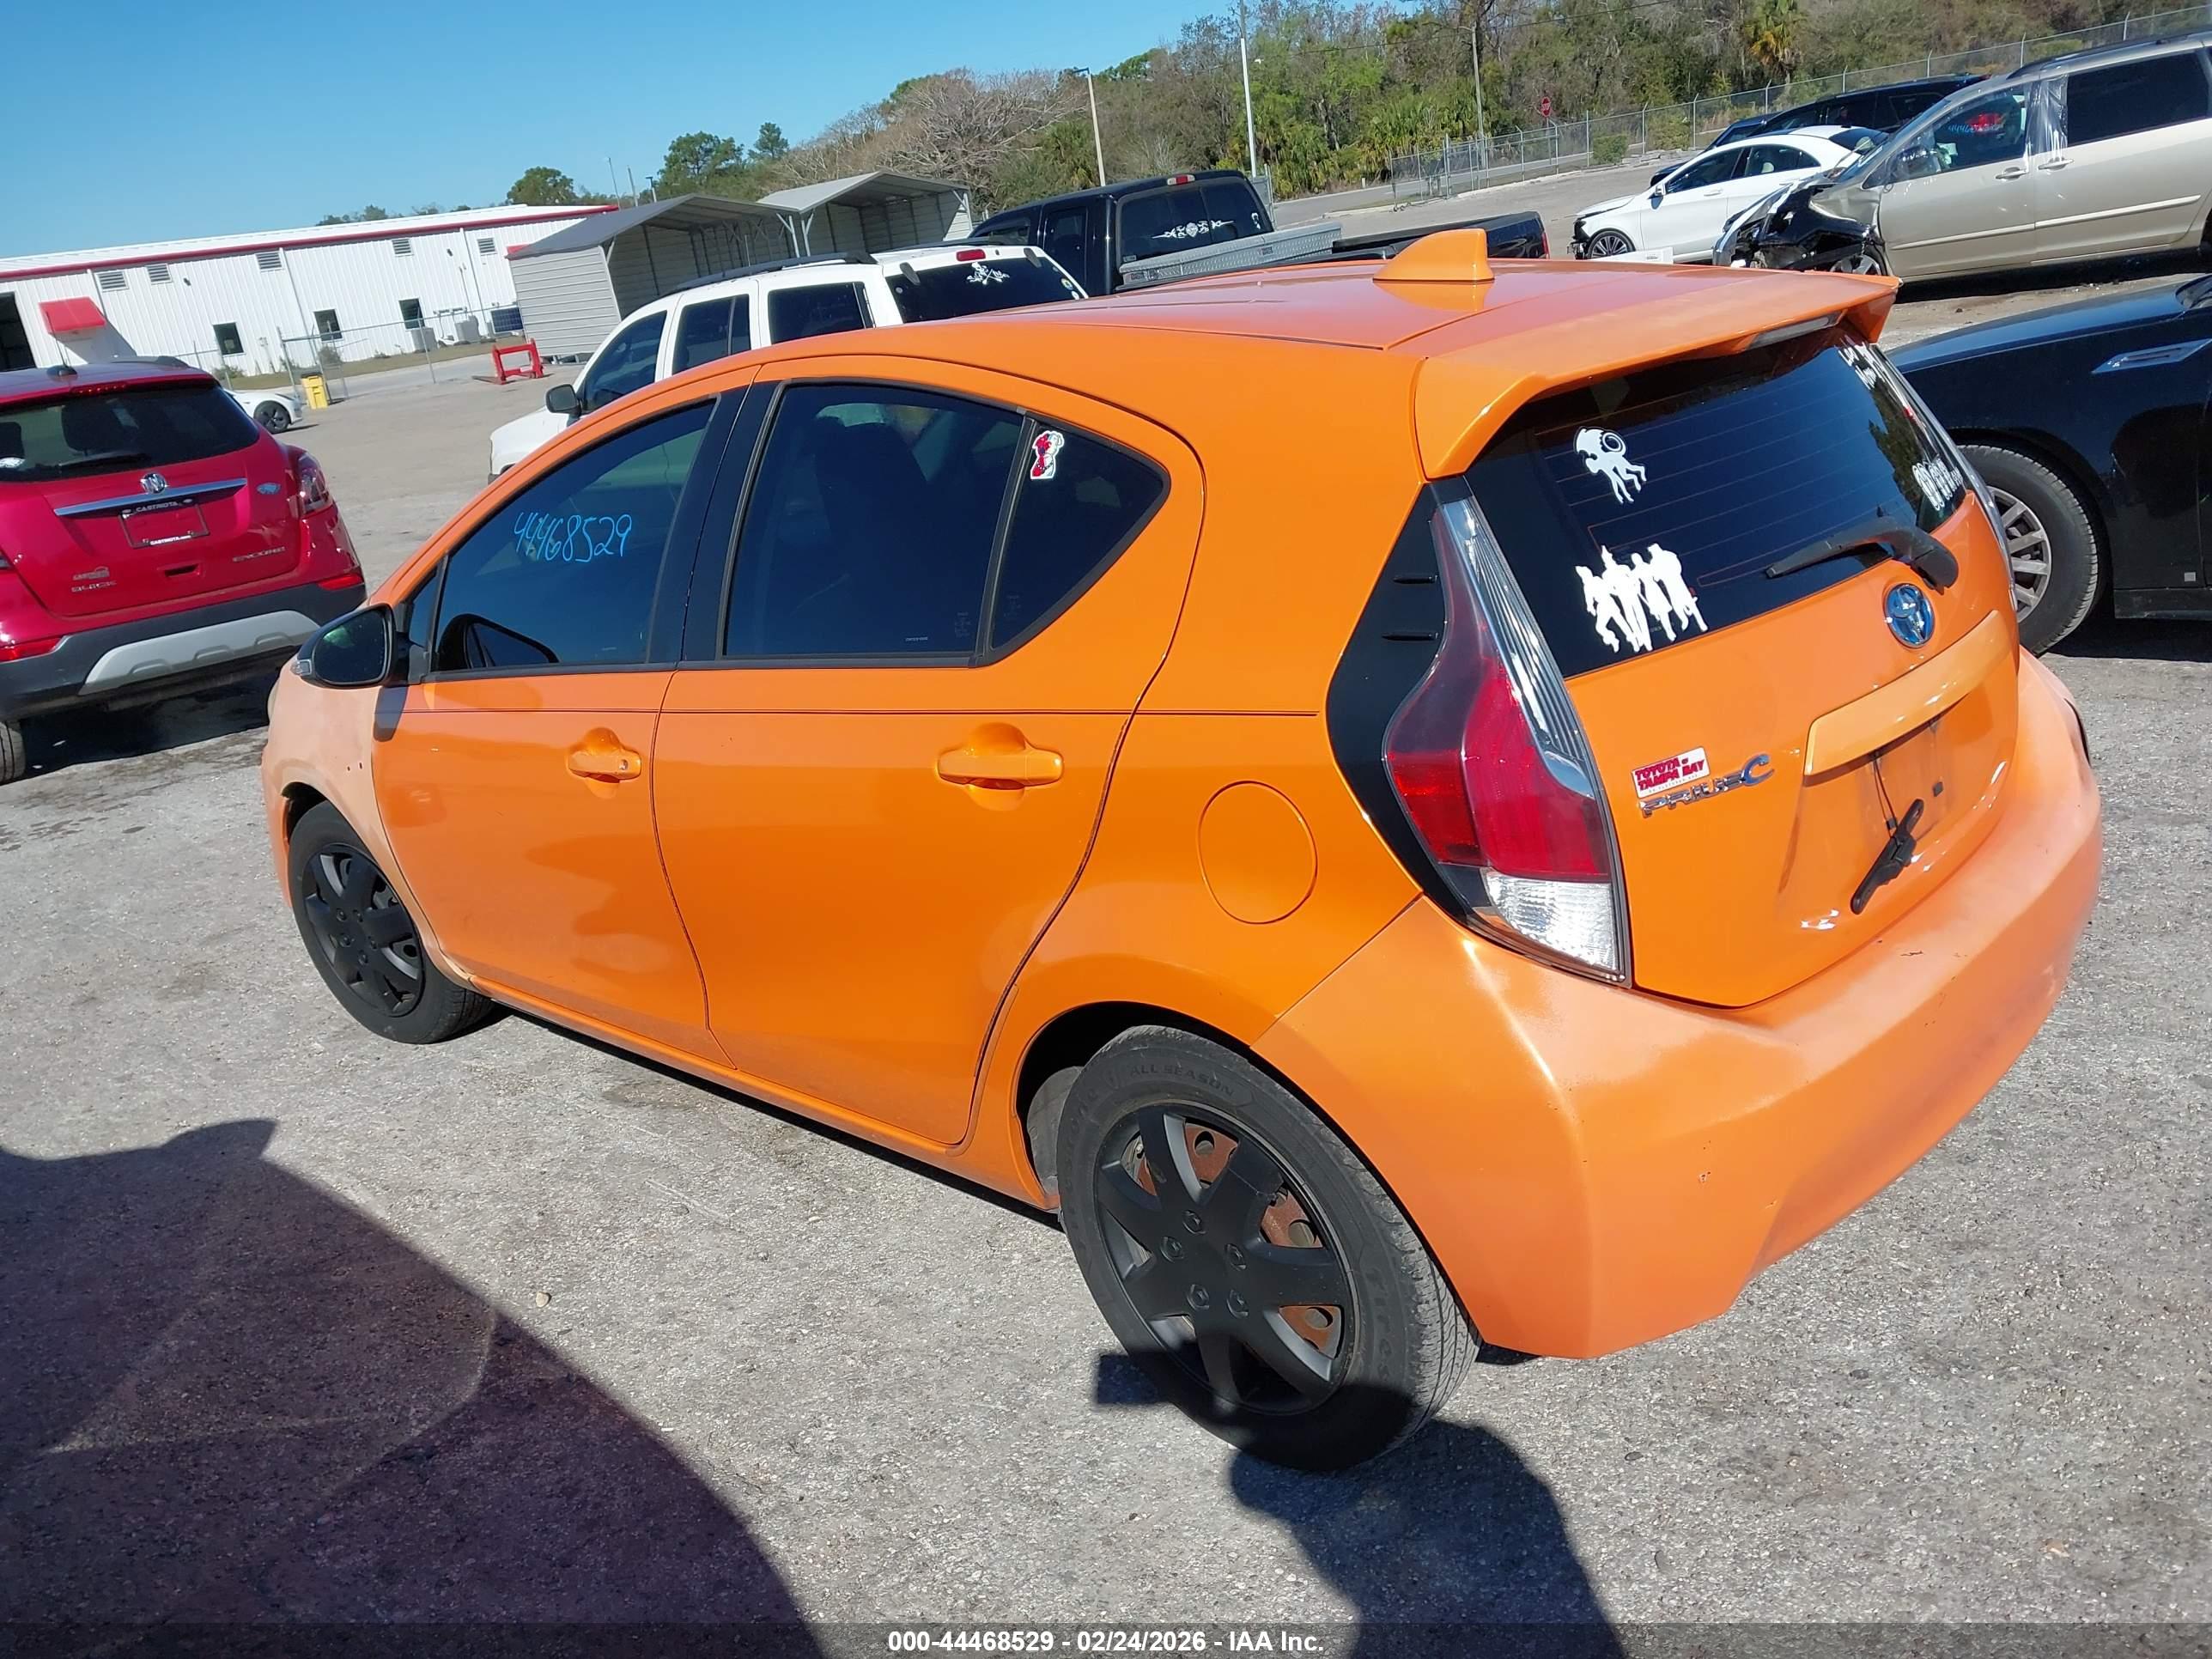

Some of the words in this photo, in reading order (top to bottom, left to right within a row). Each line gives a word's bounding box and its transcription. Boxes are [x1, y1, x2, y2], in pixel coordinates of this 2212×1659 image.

[514, 512, 633, 562] 44468529
[1634, 757, 1680, 781] TOYOTA
[1638, 768, 1680, 791] TAMPA
[1682, 759, 1705, 776] BAY
